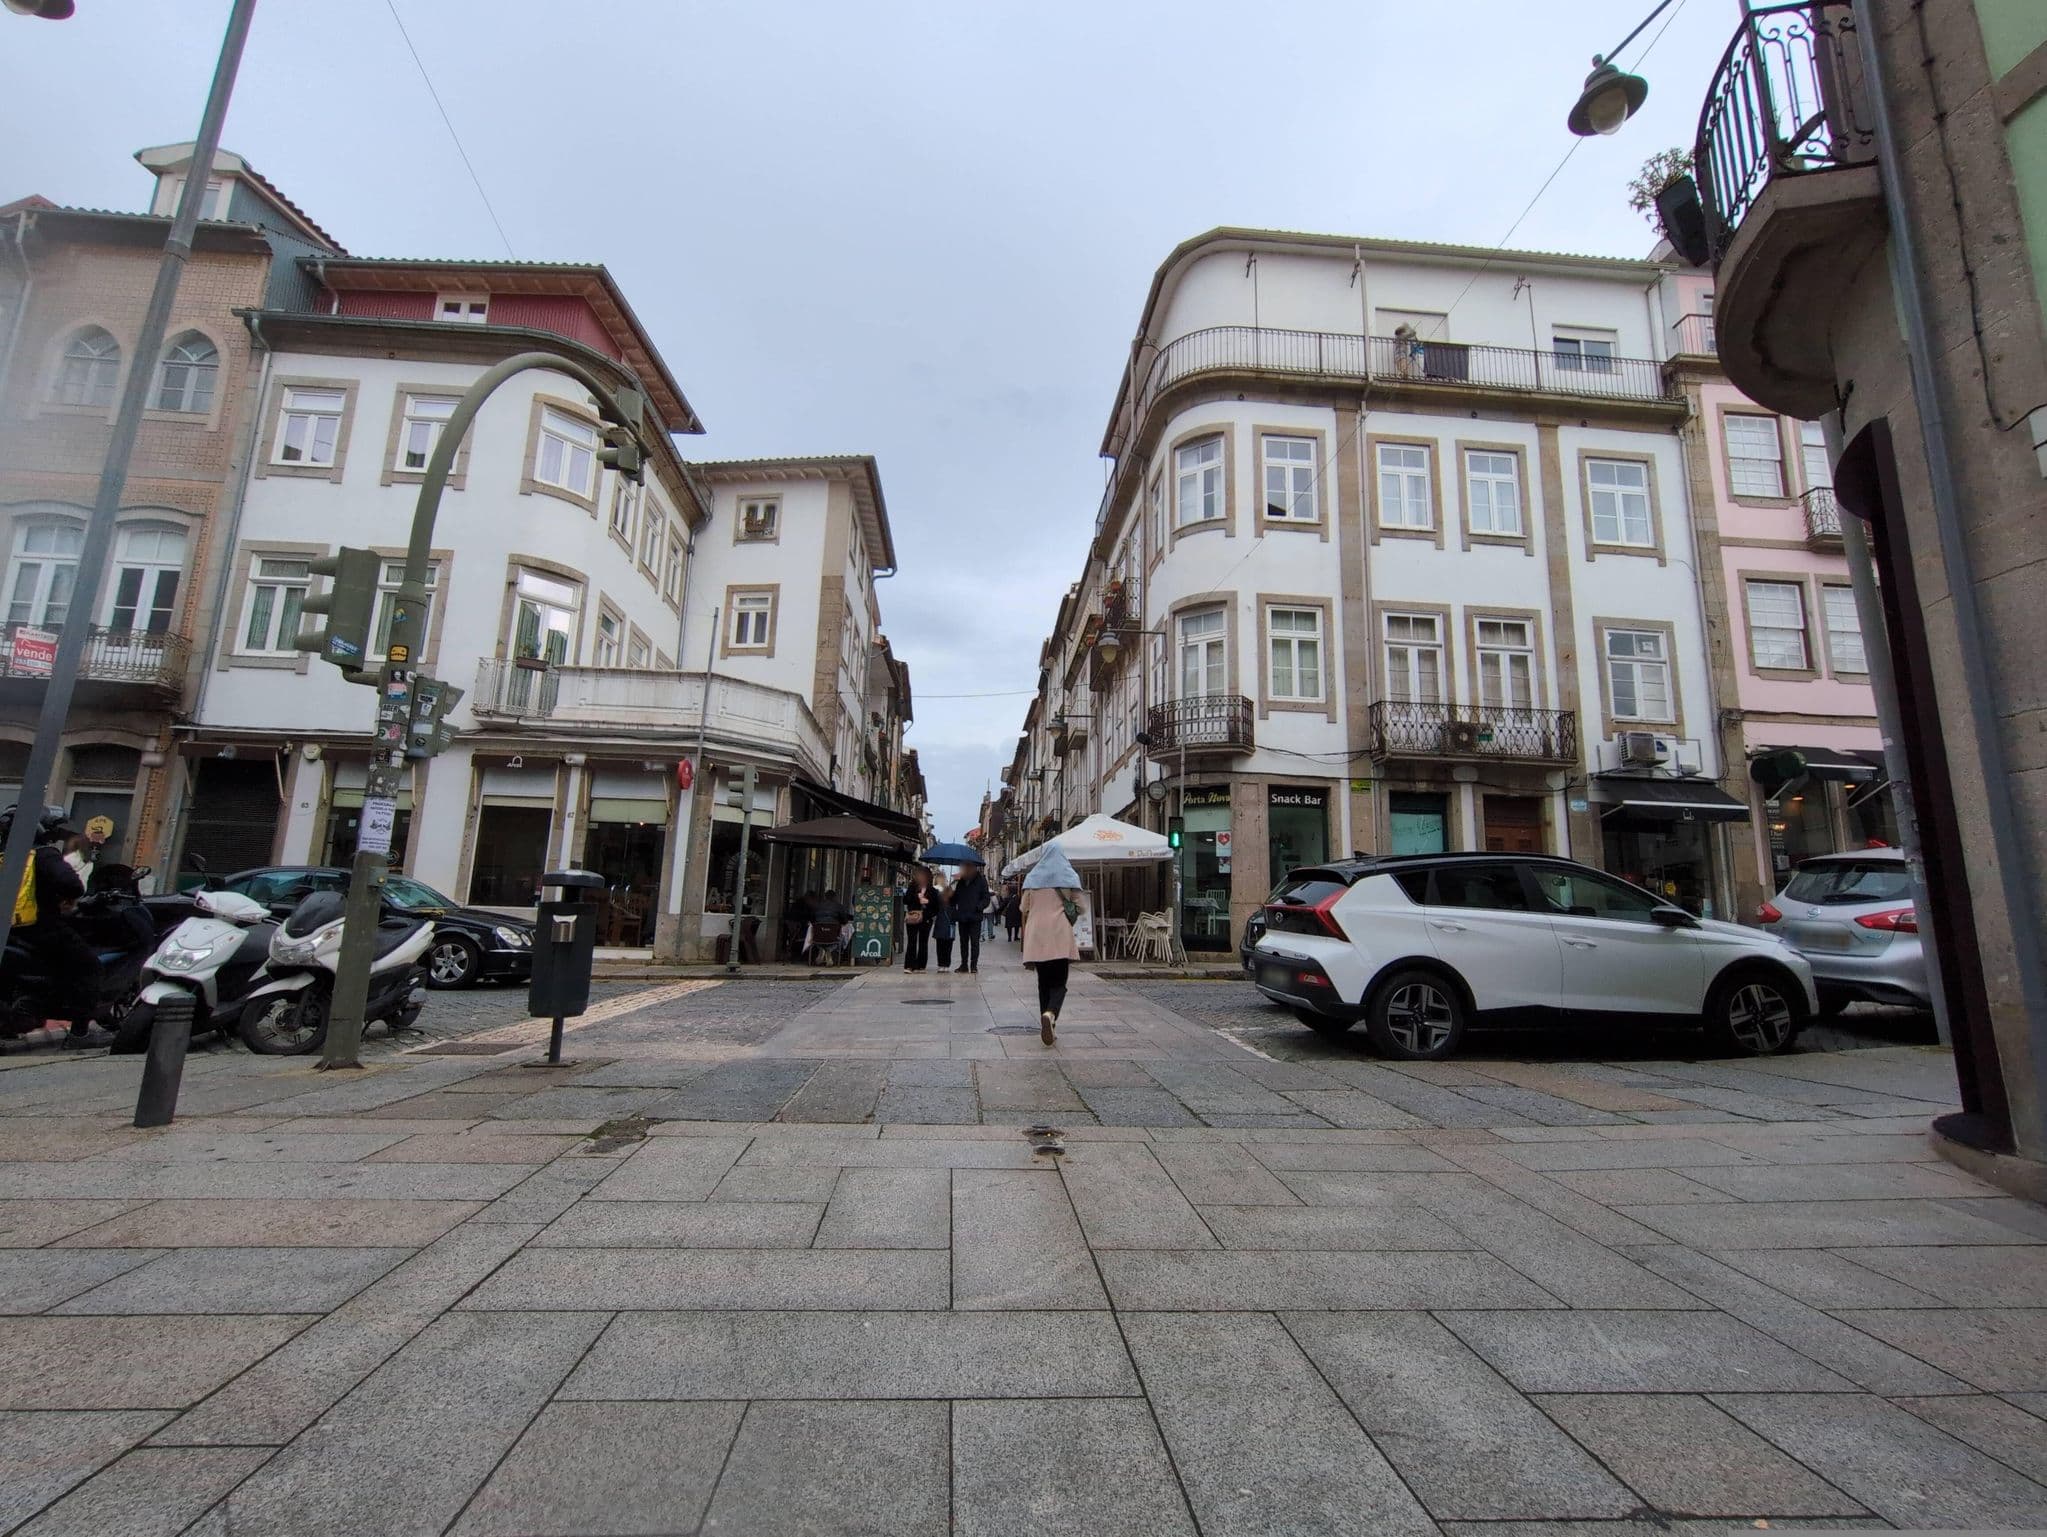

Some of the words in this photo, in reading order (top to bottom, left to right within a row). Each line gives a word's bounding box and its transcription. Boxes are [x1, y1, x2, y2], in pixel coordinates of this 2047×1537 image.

[16, 647, 53, 661] vende
[1183, 792, 1206, 804] Porta
[1271, 793, 1302, 804] Snack
[1304, 795, 1322, 805] Bar
